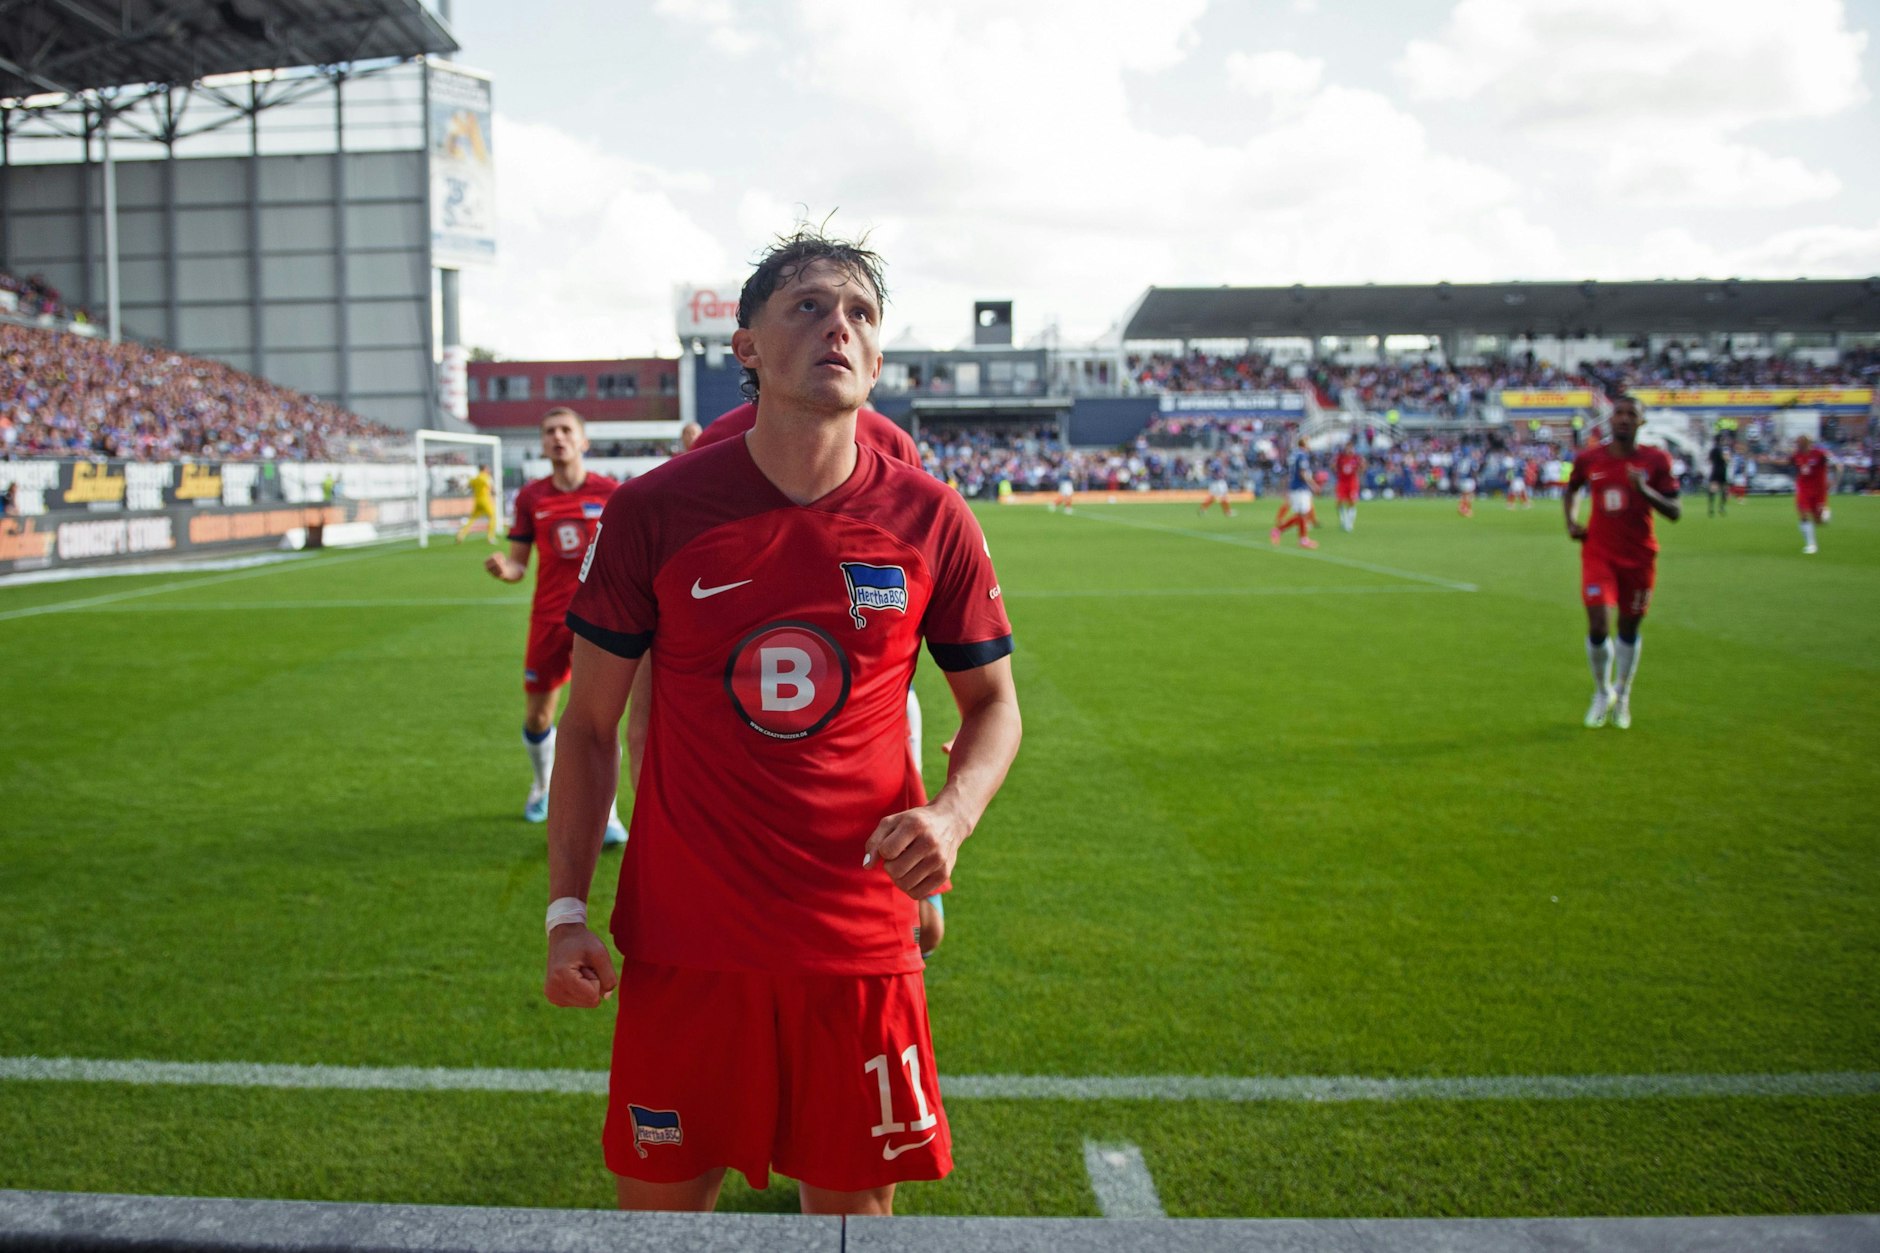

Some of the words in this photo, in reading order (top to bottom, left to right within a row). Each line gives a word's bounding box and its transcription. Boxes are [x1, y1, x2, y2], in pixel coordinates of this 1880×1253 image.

[558, 525, 580, 551] B
[760, 646, 815, 712] B
[864, 1044, 938, 1138] 11
